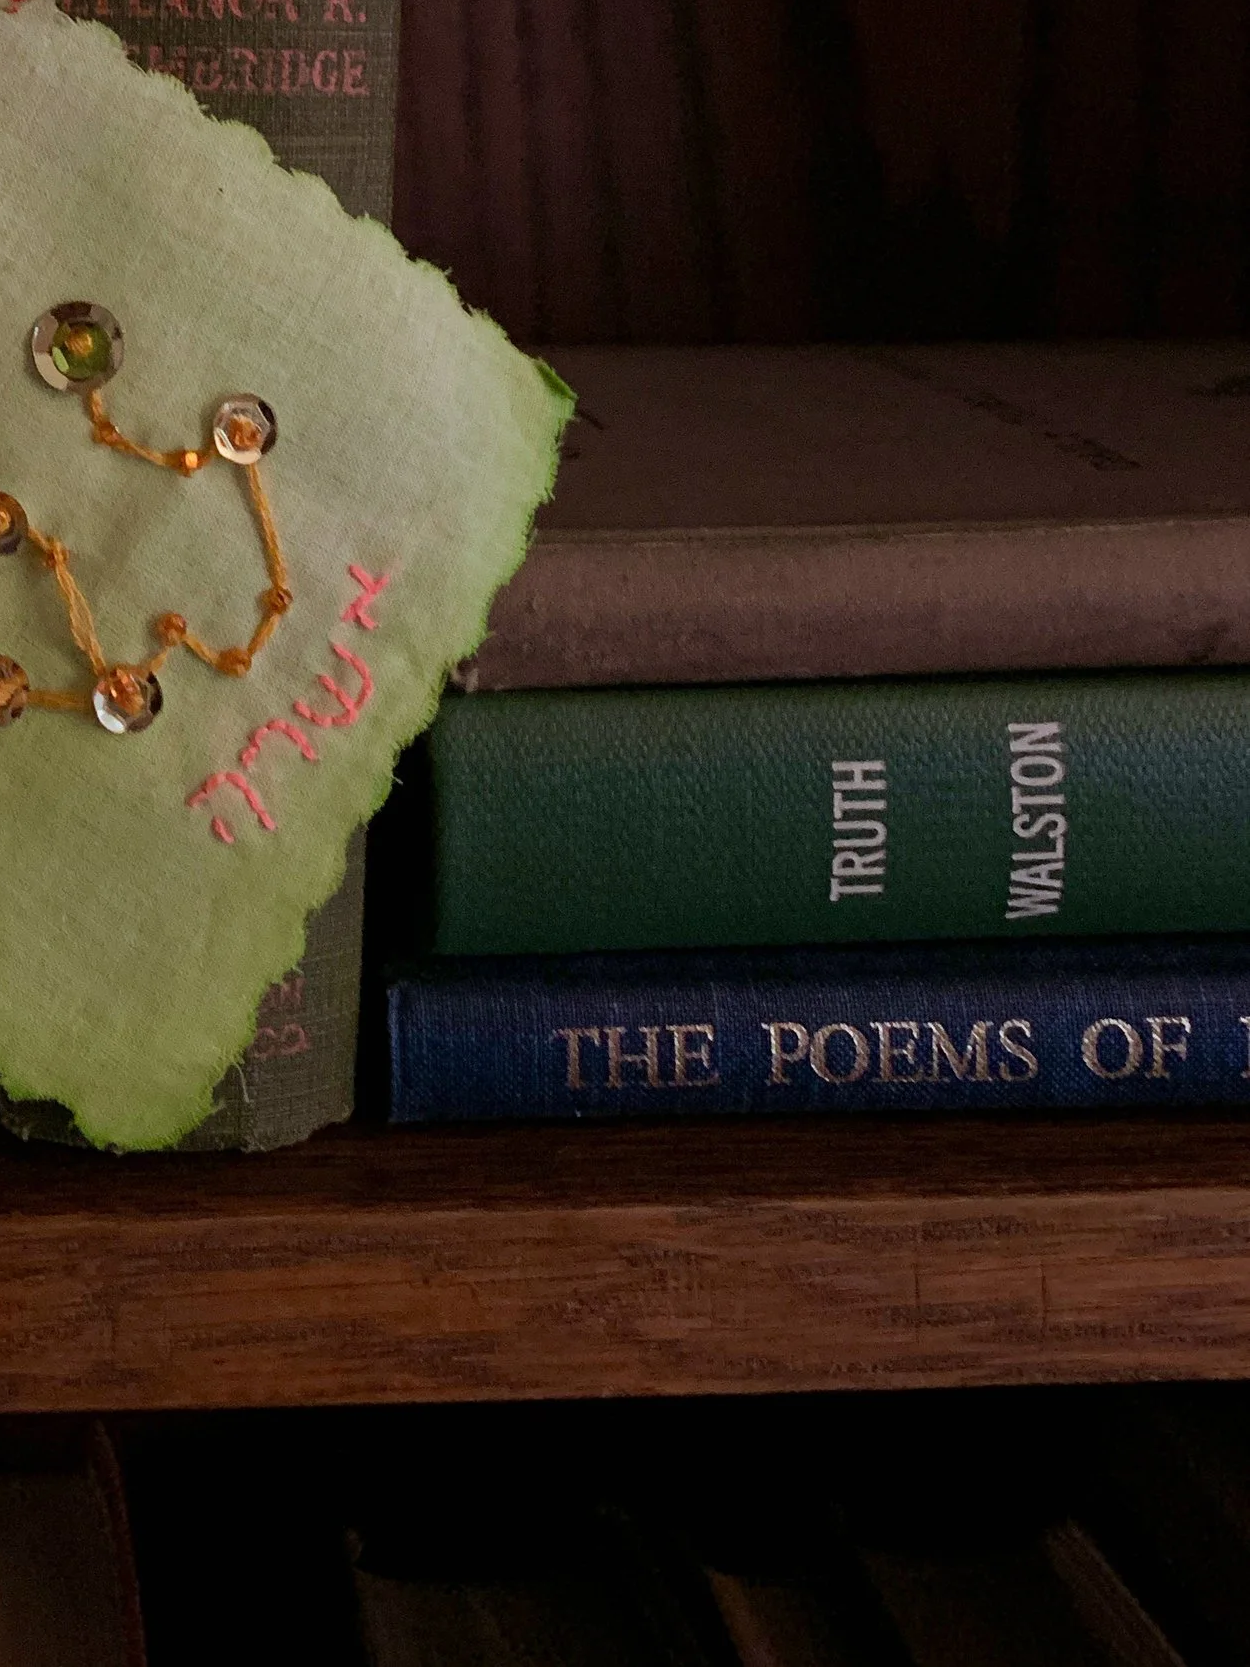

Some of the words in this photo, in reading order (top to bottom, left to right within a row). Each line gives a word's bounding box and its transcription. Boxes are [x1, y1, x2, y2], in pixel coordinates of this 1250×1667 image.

[828, 759, 888, 902] TRUTH
[1004, 720, 1068, 920] WALSTON
[552, 1023, 720, 1091] THE
[761, 1018, 1041, 1086] POEMS
[1080, 1015, 1193, 1082] OF
